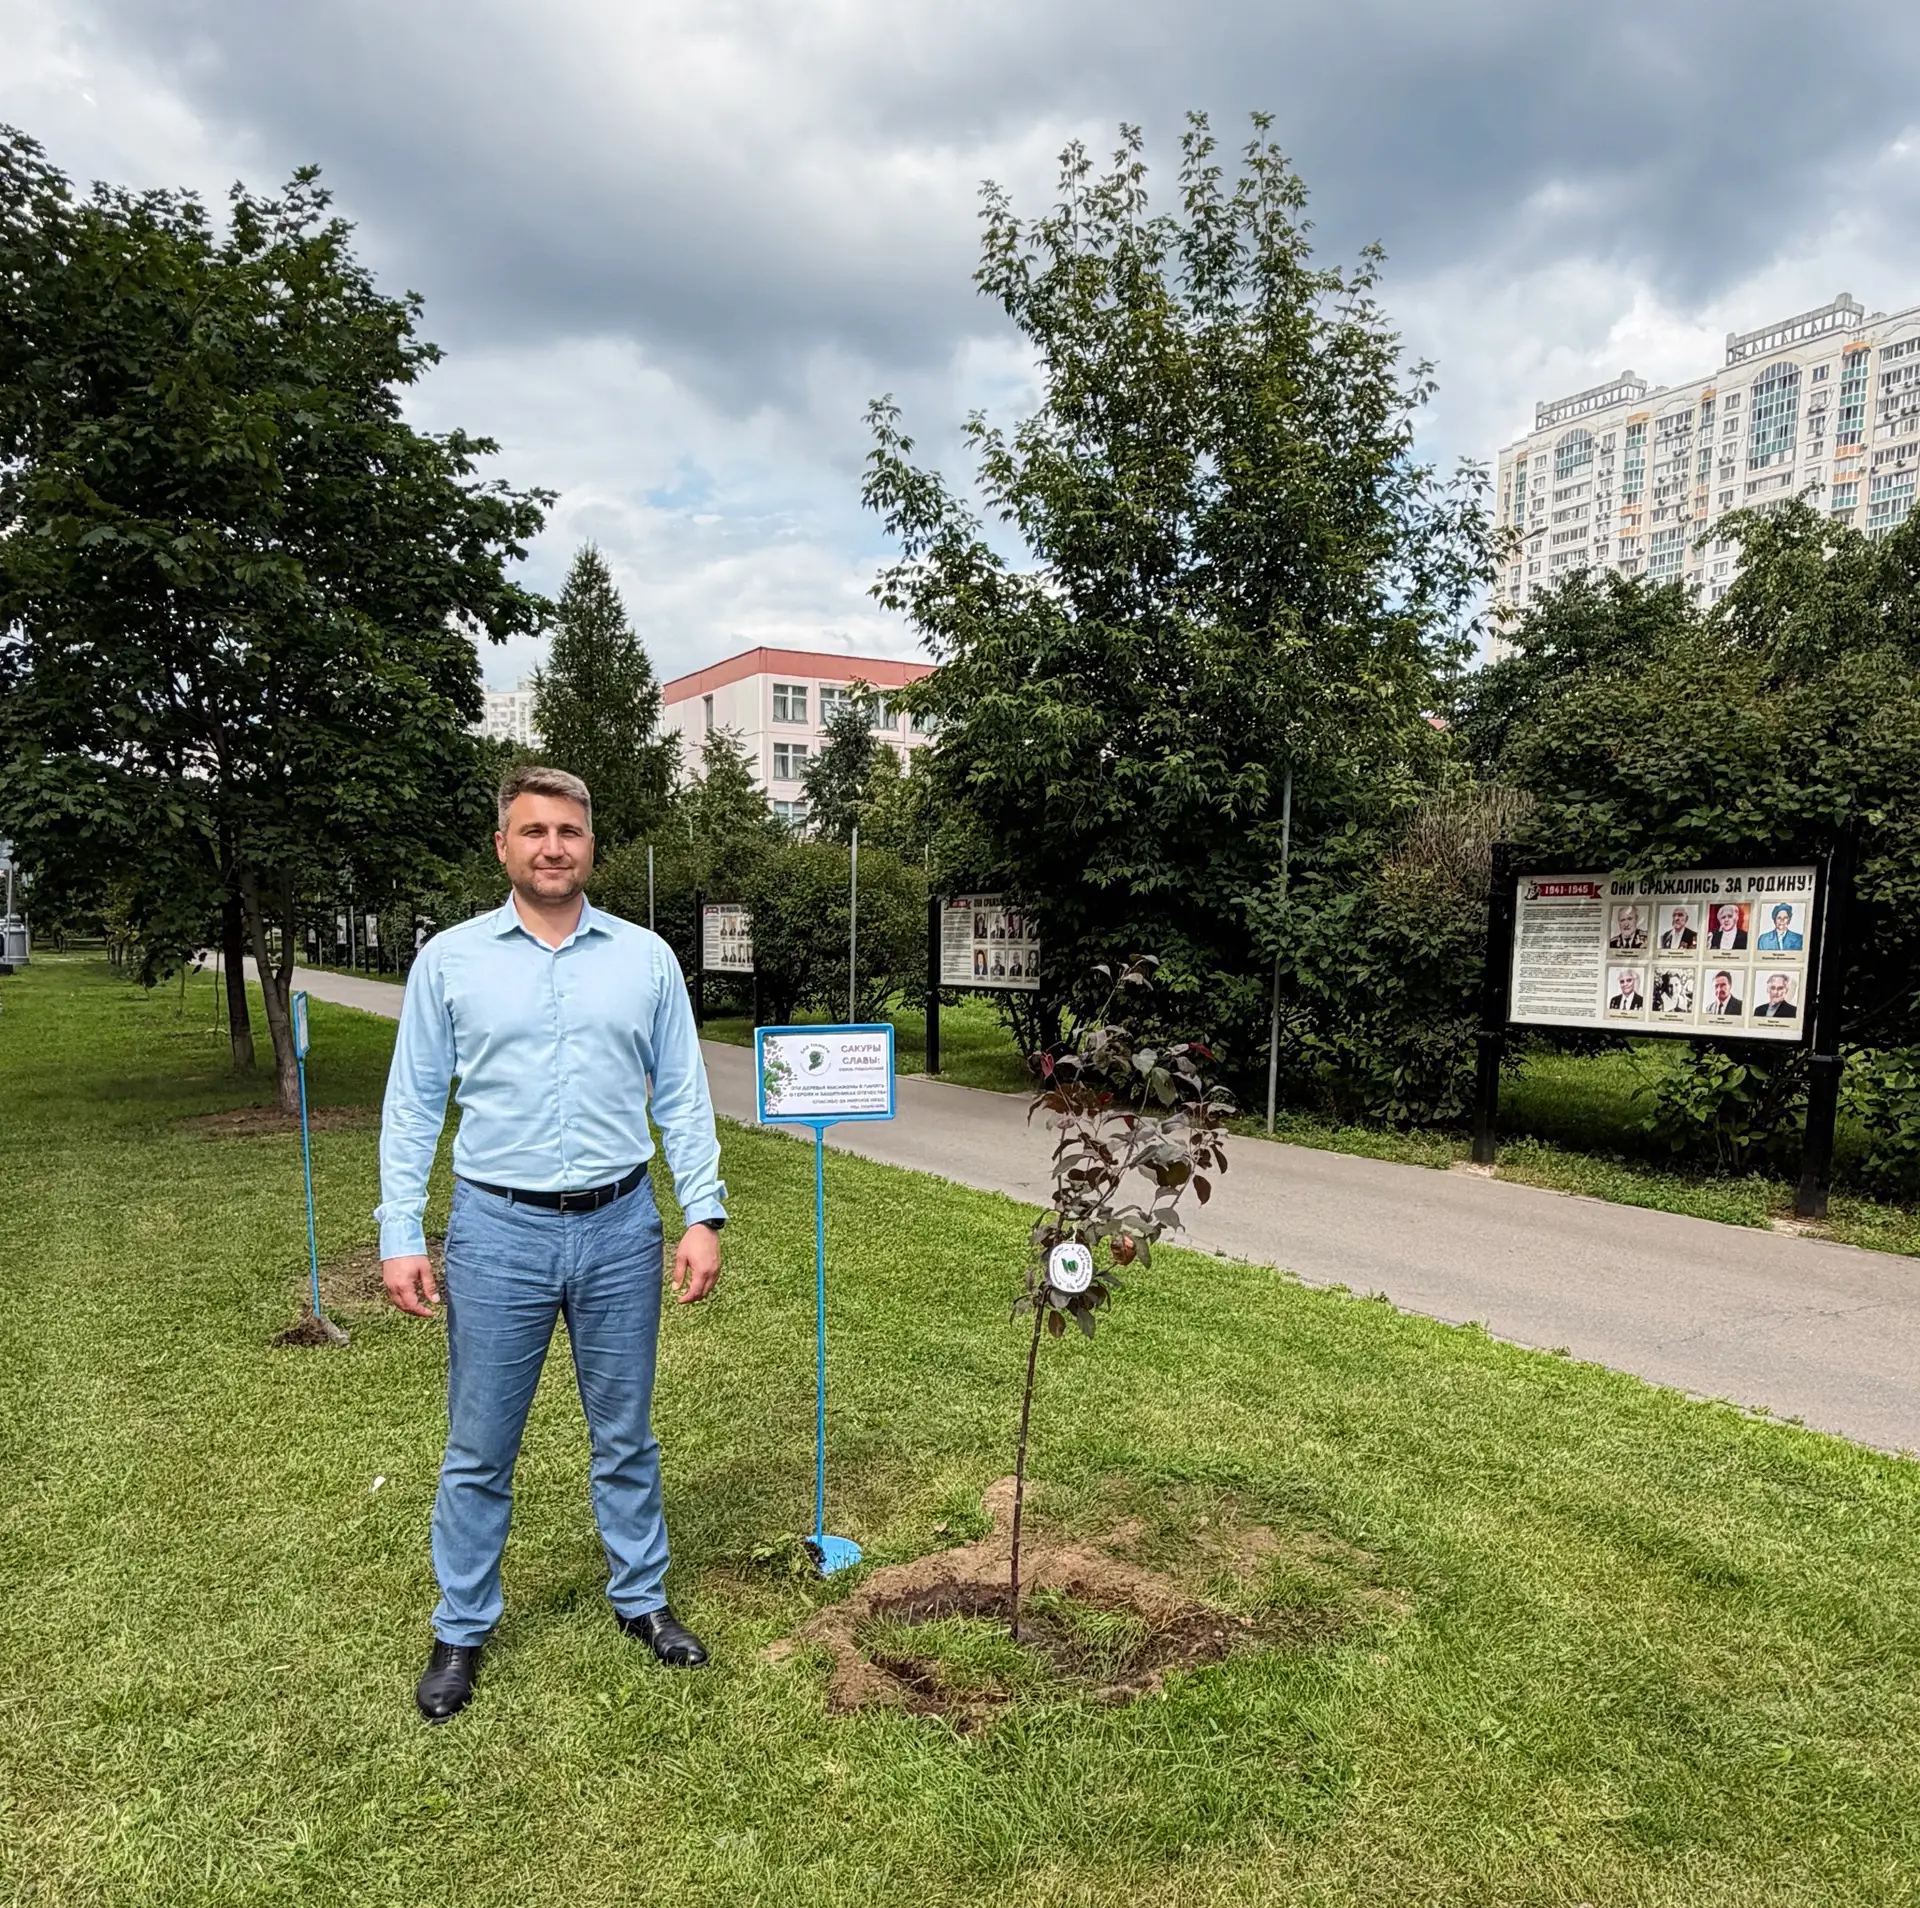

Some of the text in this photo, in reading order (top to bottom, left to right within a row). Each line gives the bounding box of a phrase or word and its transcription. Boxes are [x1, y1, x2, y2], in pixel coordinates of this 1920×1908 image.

[1545, 885, 1589, 894] 1941-1945
[1610, 875, 1813, 895] ОНИ СРАЖАЛИСЬ ЗА РОДИНУ!
[841, 1044, 881, 1053] САКУРЫ
[842, 1057, 880, 1065] СЛАВЫ:
